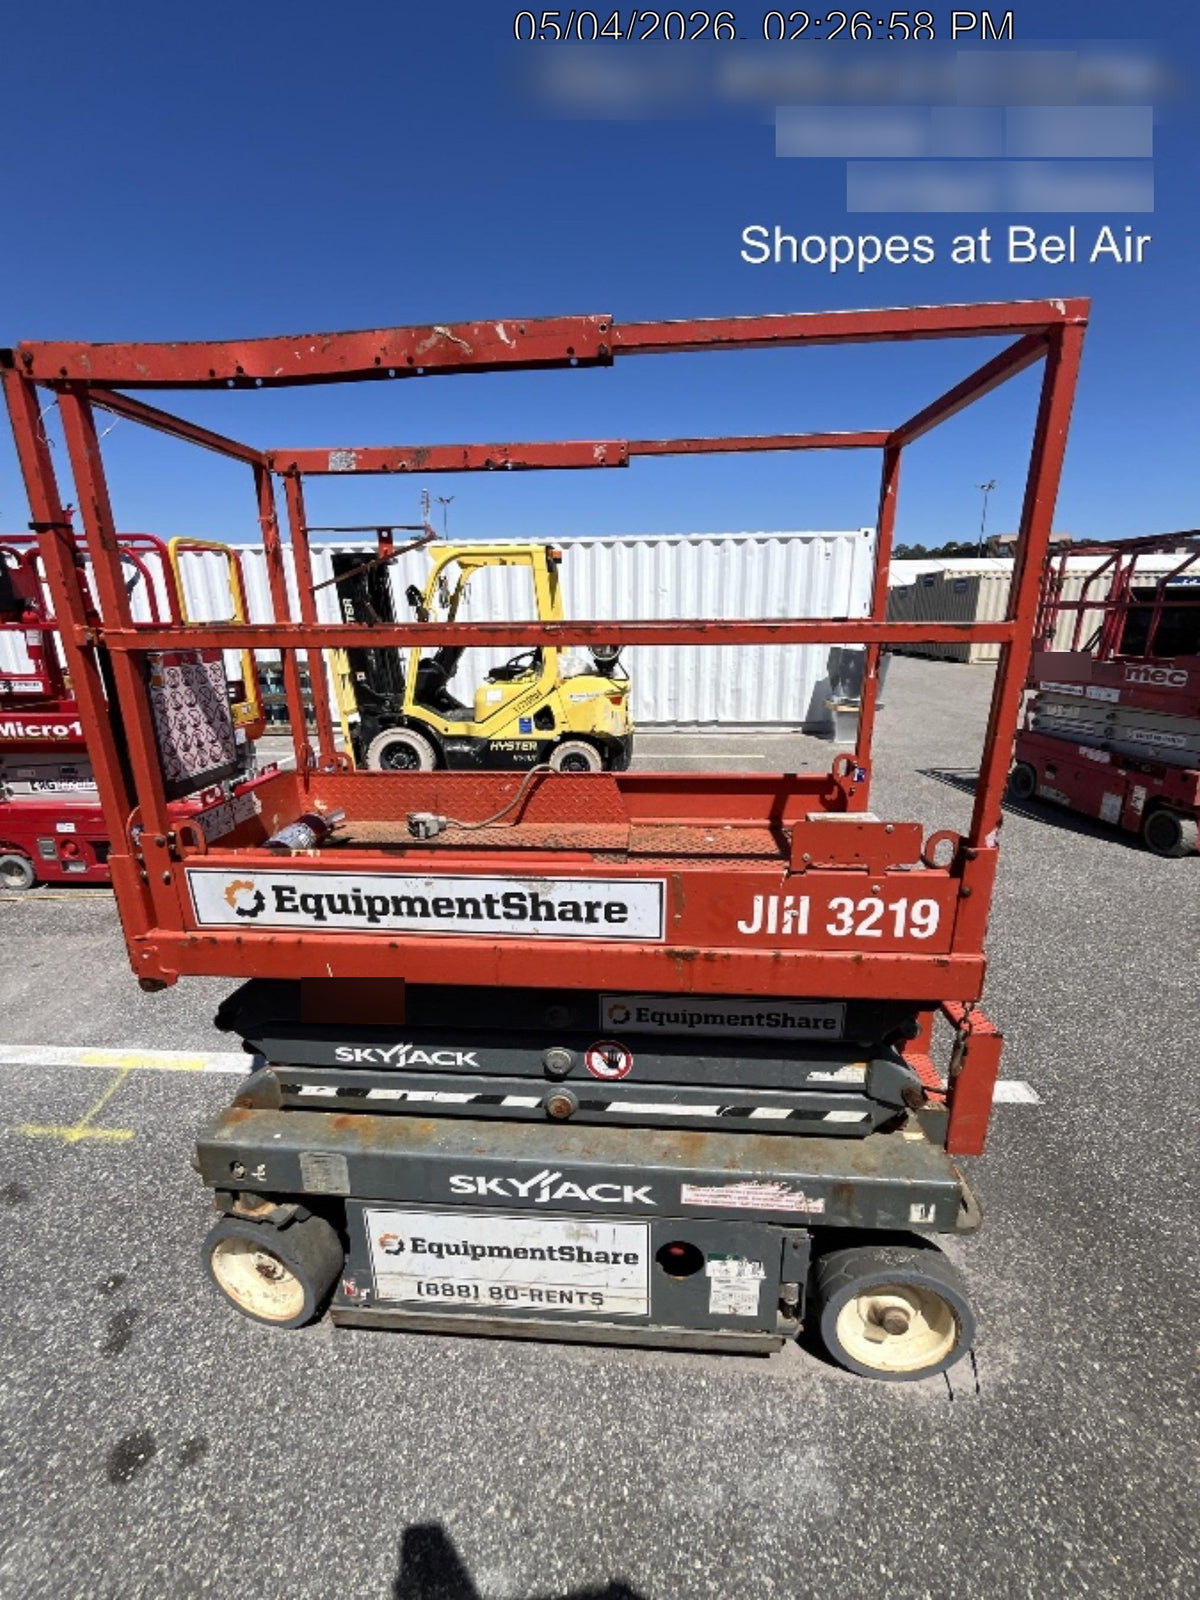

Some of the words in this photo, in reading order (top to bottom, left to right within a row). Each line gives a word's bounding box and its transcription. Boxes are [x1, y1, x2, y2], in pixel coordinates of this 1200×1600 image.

[1125, 664, 1189, 687] mec
[490, 741, 538, 751] HYSTER
[271, 885, 628, 923] EquipmentShare
[826, 896, 939, 939] 3219
[636, 1007, 837, 1030] EquipmentShare
[335, 1042, 480, 1067] SKYJACK
[449, 1169, 658, 1206] SKYJACK
[410, 1237, 639, 1265] EquipmentShare
